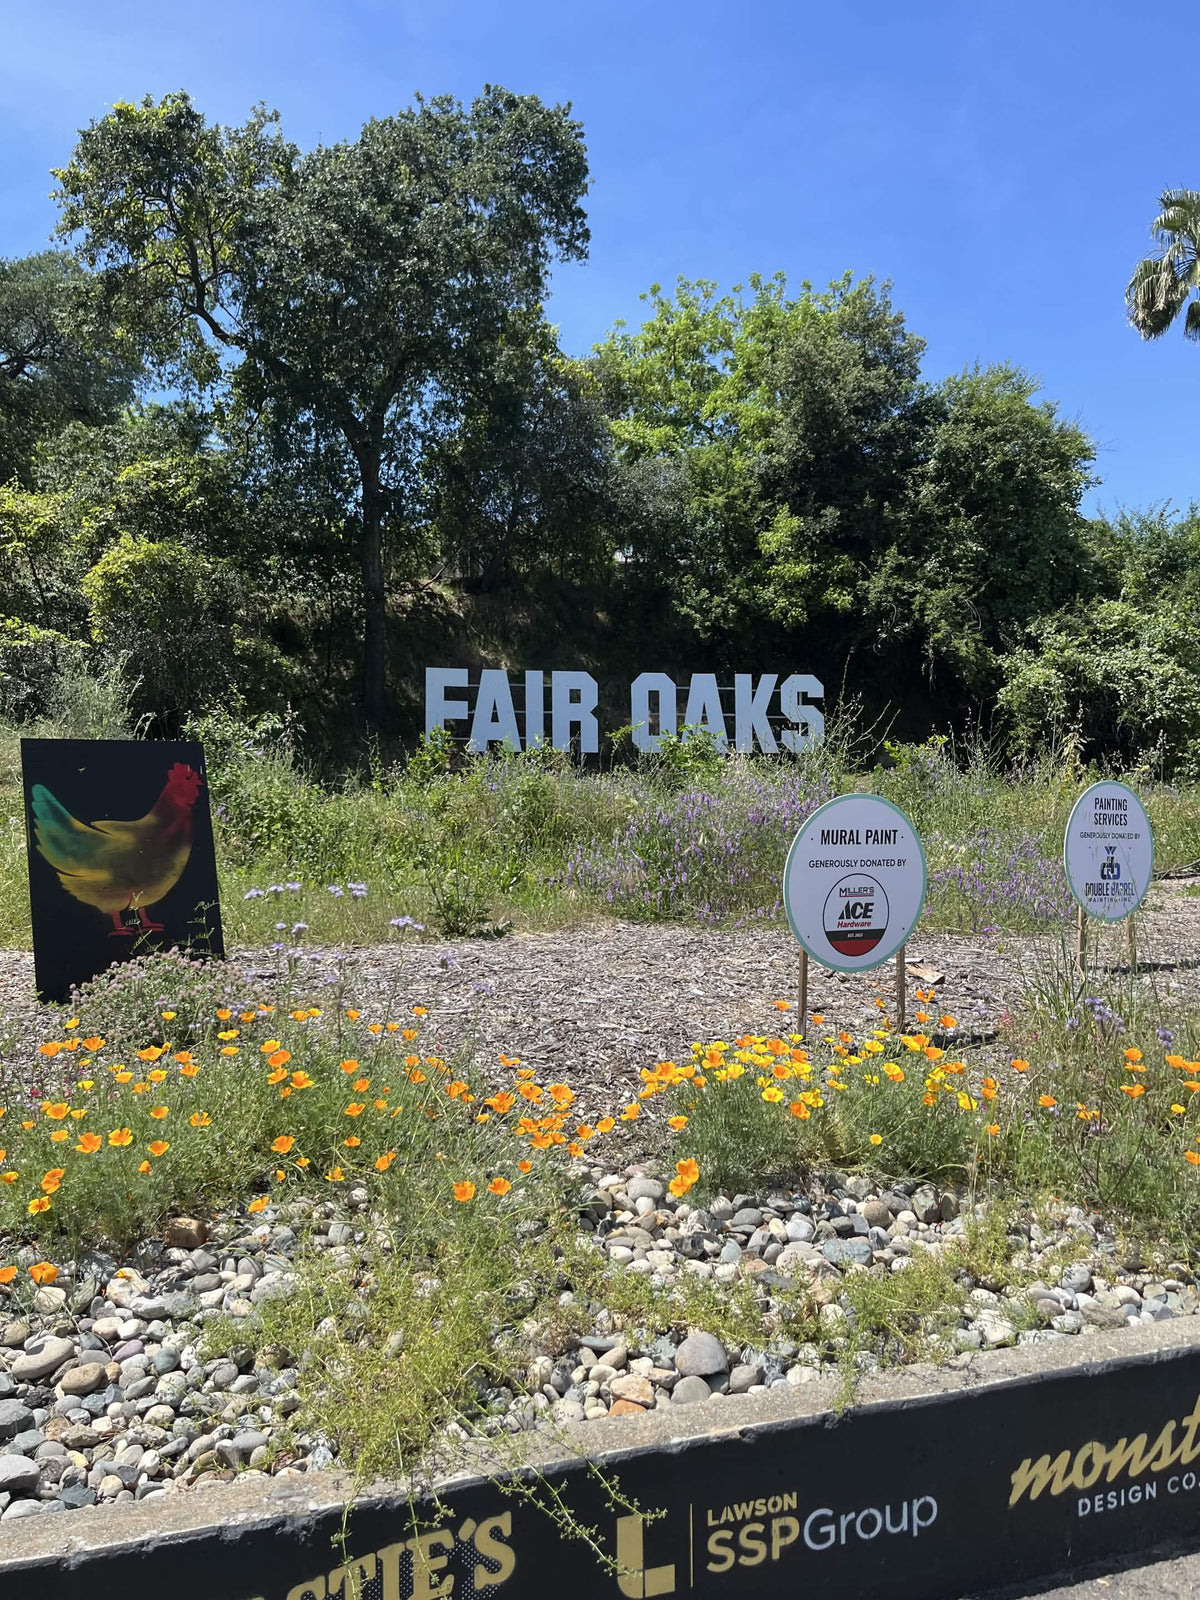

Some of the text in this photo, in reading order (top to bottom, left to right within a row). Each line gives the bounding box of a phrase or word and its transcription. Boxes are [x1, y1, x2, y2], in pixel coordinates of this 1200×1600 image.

[425, 667, 825, 754] FAIR OAKS
[1094, 797, 1128, 811] PAINTING
[1094, 813, 1128, 826] SERVICES
[820, 829, 898, 845] MURAL PAINT
[1079, 831, 1110, 839] GENEROUSLY
[808, 858, 906, 868] GENEROUSLY DONATED BY
[1085, 882, 1110, 896] DOUBLE
[838, 899, 874, 920] ACE
[837, 920, 872, 928] Hardware
[1078, 1481, 1157, 1517] DESIGN
[707, 1491, 798, 1527] LAWSON
[248, 1511, 516, 1600] TIE'S
